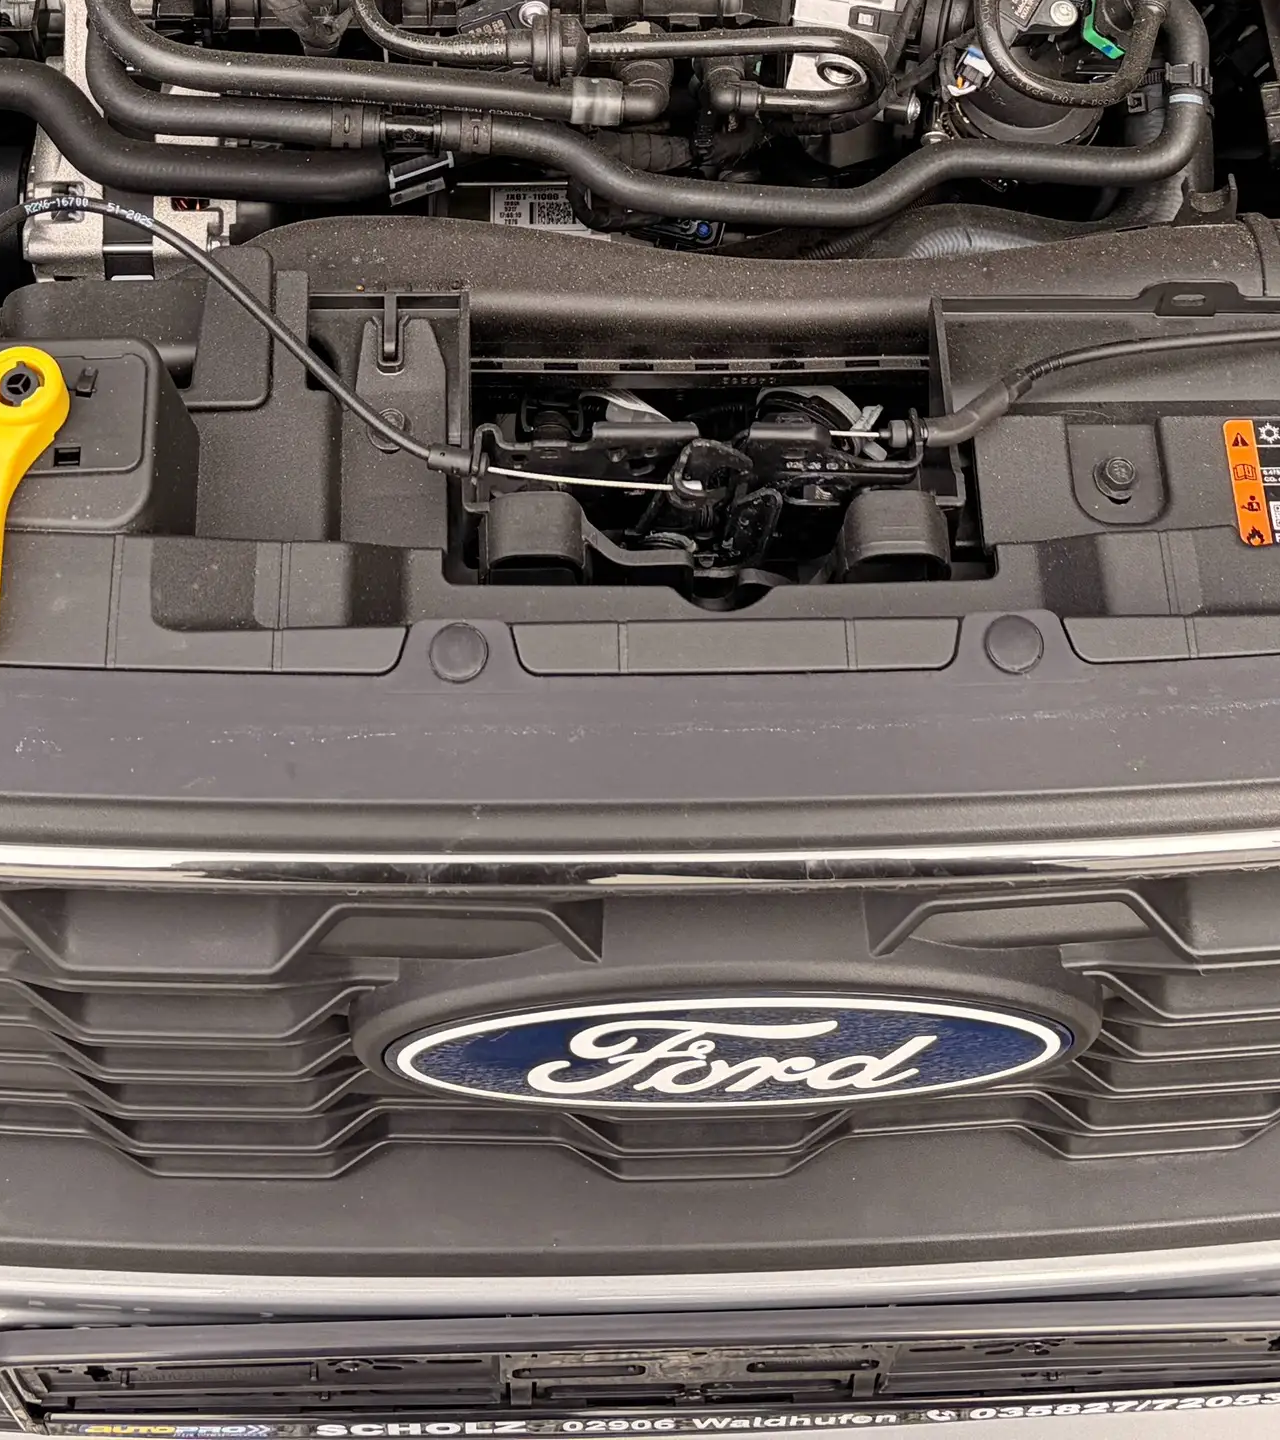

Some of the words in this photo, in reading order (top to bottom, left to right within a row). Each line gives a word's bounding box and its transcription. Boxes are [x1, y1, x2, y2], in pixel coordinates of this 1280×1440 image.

[106, 202, 156, 227] 51-2025
[527, 1019, 938, 1095] Ford
[316, 1420, 528, 1437] SCHOLZ
[562, 1418, 676, 1432] 02906
[693, 1412, 897, 1429] Waldhufen
